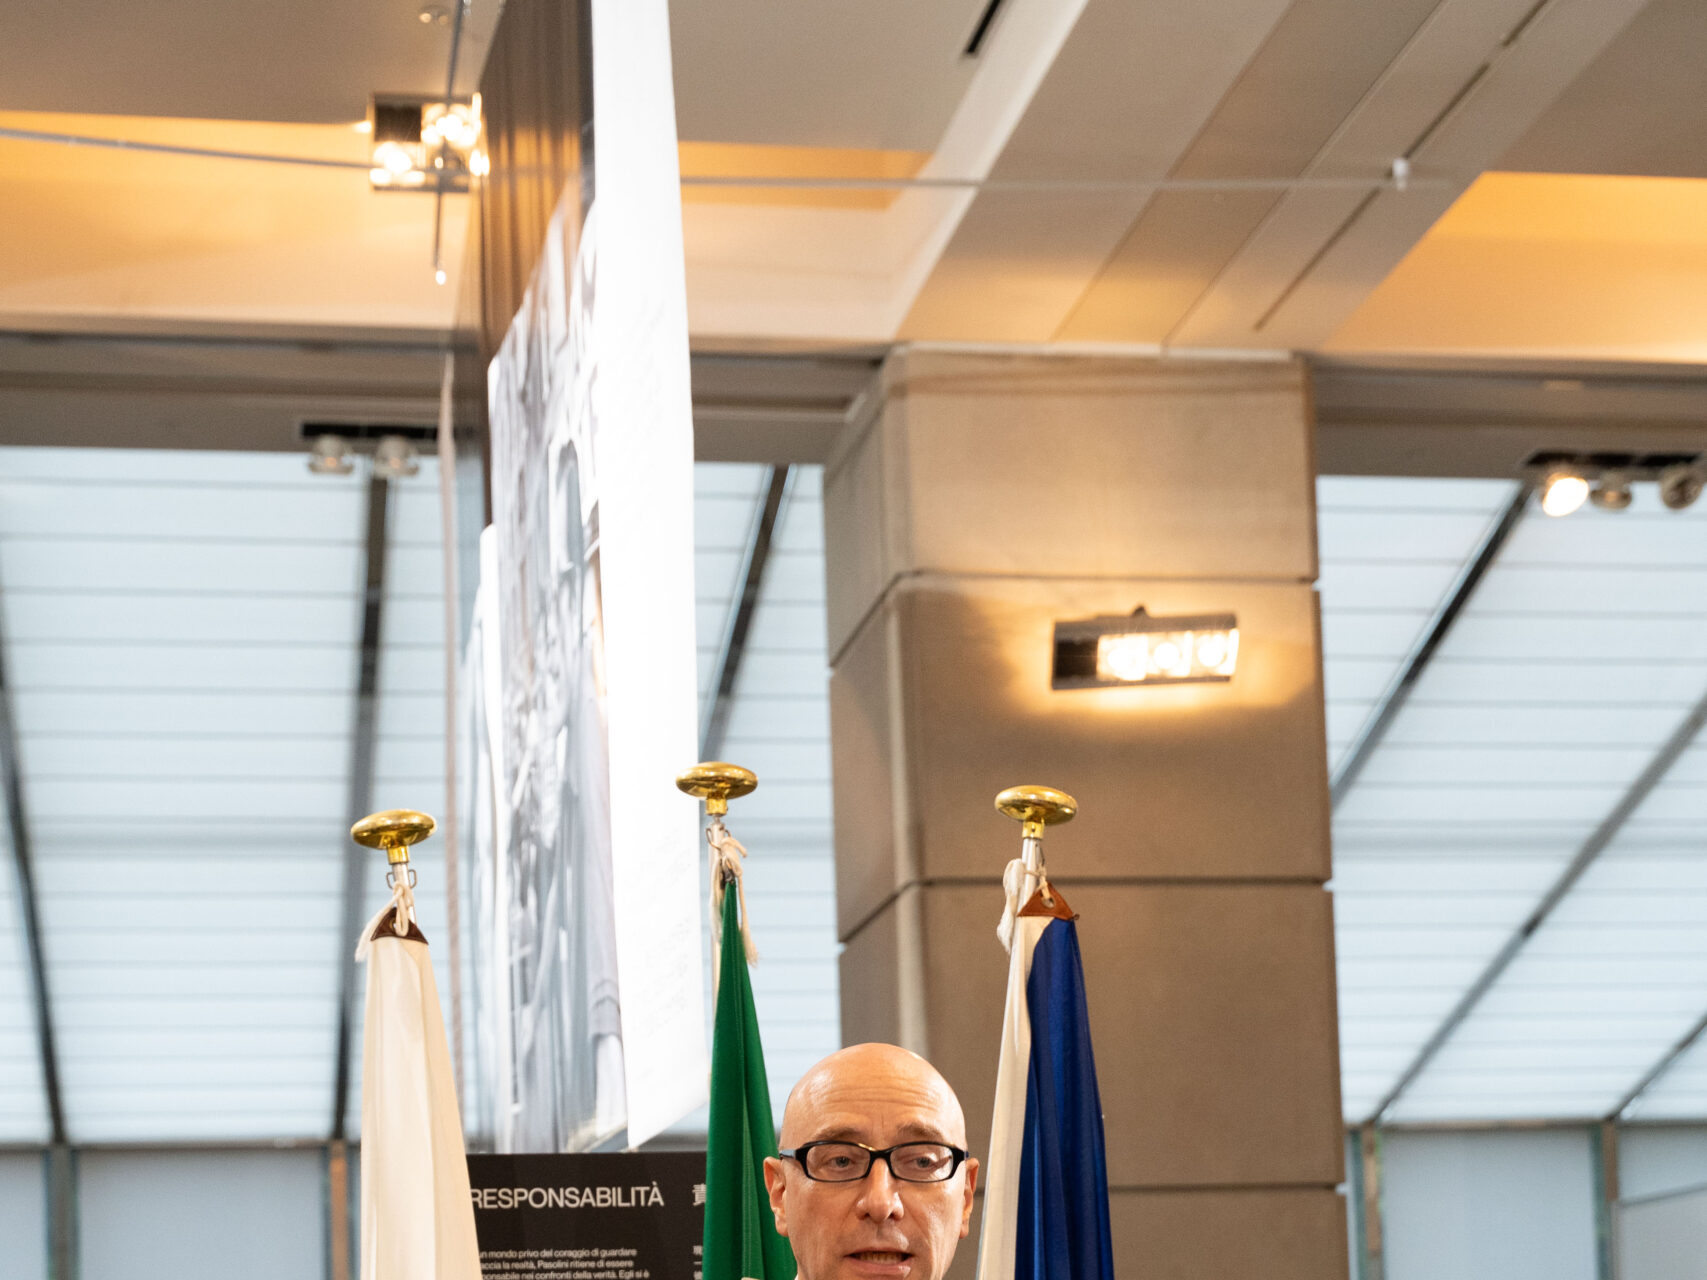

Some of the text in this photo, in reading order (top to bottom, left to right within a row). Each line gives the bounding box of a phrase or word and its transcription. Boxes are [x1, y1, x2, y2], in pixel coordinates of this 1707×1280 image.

[471, 1181, 665, 1209] RESPONSABILITÀ
[489, 1249, 517, 1259] mondo
[518, 1249, 539, 1259] privo
[554, 1248, 590, 1259] coraggio
[591, 1248, 599, 1257] di
[600, 1248, 637, 1258] guardare
[537, 1260, 569, 1269] Pasolini
[597, 1260, 605, 1268] di
[605, 1260, 634, 1268] essere
[535, 1271, 571, 1280] confronti
[619, 1270, 634, 1280] Egli
